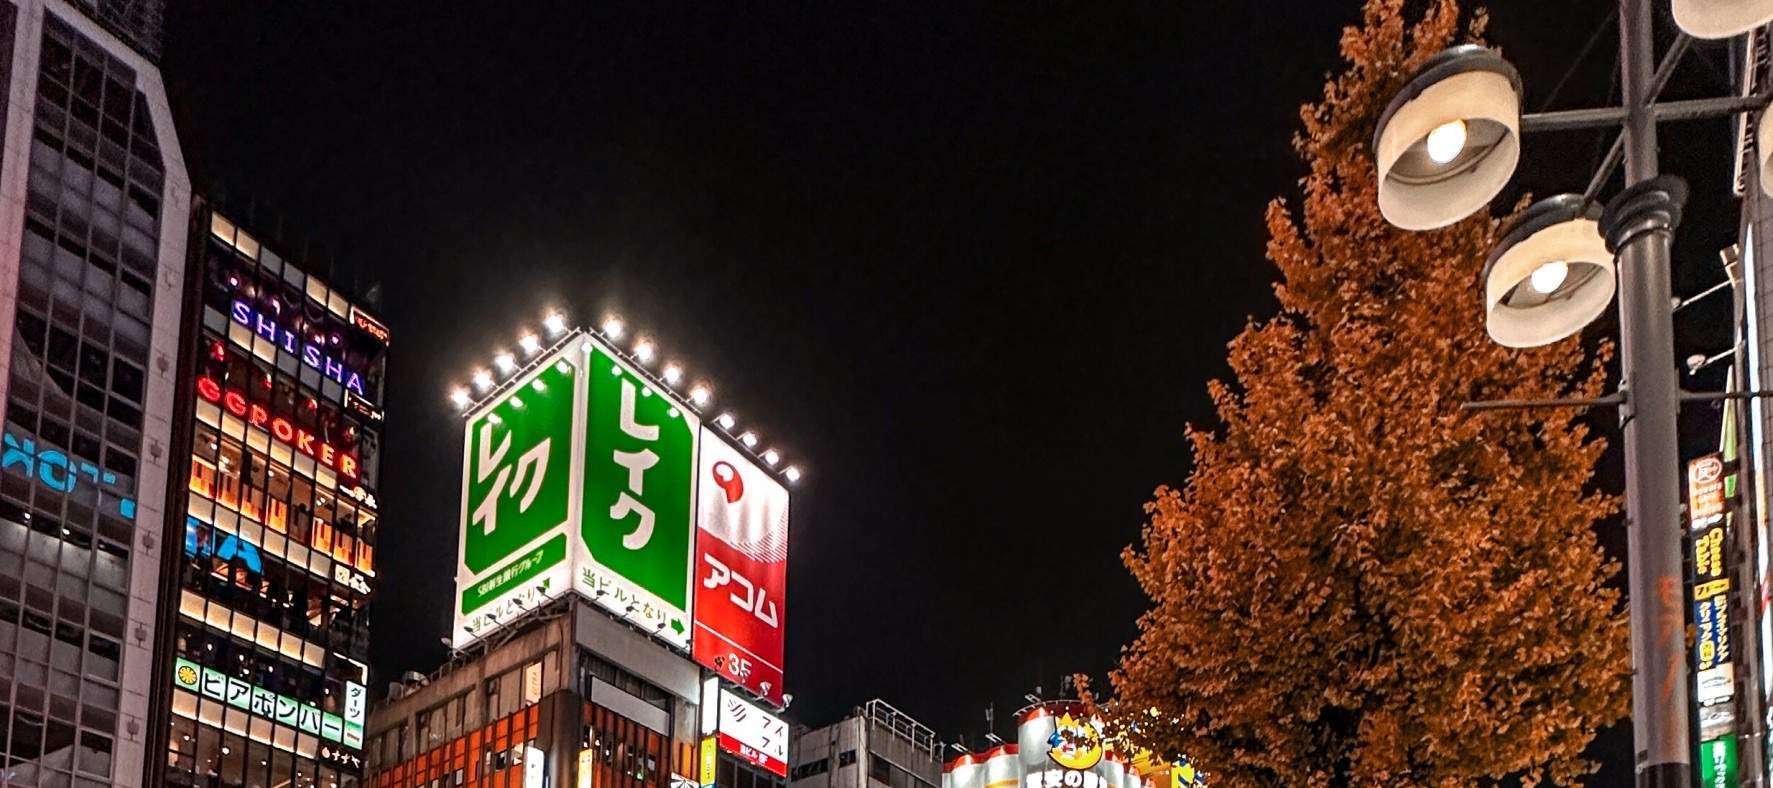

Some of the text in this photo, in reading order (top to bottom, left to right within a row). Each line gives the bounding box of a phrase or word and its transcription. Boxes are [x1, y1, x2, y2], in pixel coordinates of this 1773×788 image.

[232, 300, 364, 396] SHISHA
[198, 377, 358, 480] GGPOKER
[610, 378, 660, 550] レイク
[472, 422, 551, 536] レイク
[472, 586, 535, 633] 当ビルとり
[703, 552, 778, 629] アコム
[349, 687, 362, 718] ダーツ
